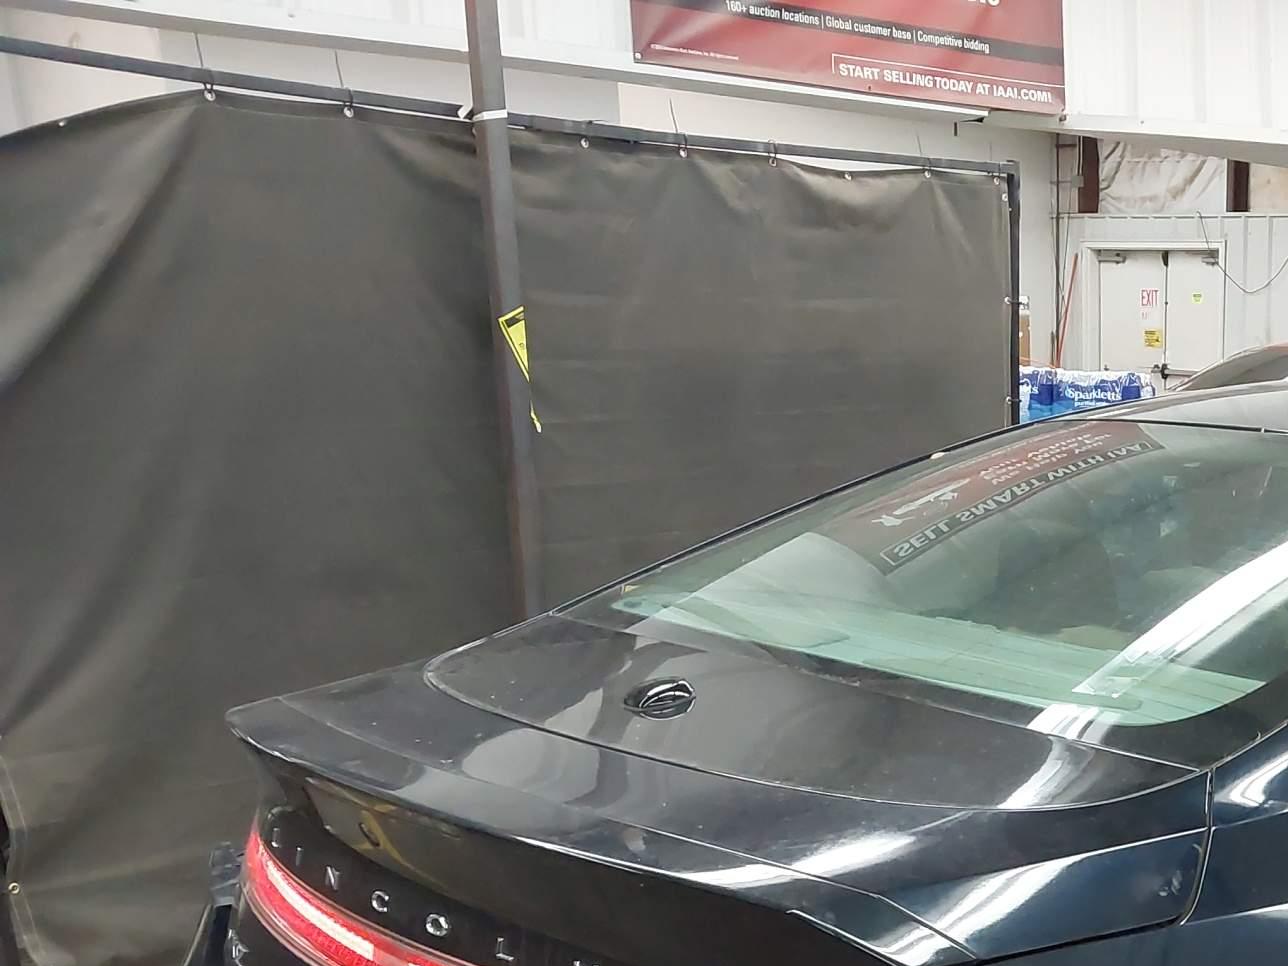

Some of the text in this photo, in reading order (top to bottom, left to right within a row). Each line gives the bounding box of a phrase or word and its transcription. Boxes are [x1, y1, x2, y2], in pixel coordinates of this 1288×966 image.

[725, 0, 748, 13] 160+
[749, 4, 781, 19] auction
[781, 8, 819, 26] locations
[825, 16, 852, 30] Global
[853, 22, 891, 37] customer
[892, 26, 912, 40] base
[917, 30, 963, 49] Competitive
[963, 34, 990, 53] bidding
[839, 63, 1052, 103] START SELLING TODAY AT IAAI.COM!
[1141, 289, 1159, 307] EXIT
[1068, 387, 1122, 402] Sparkletts
